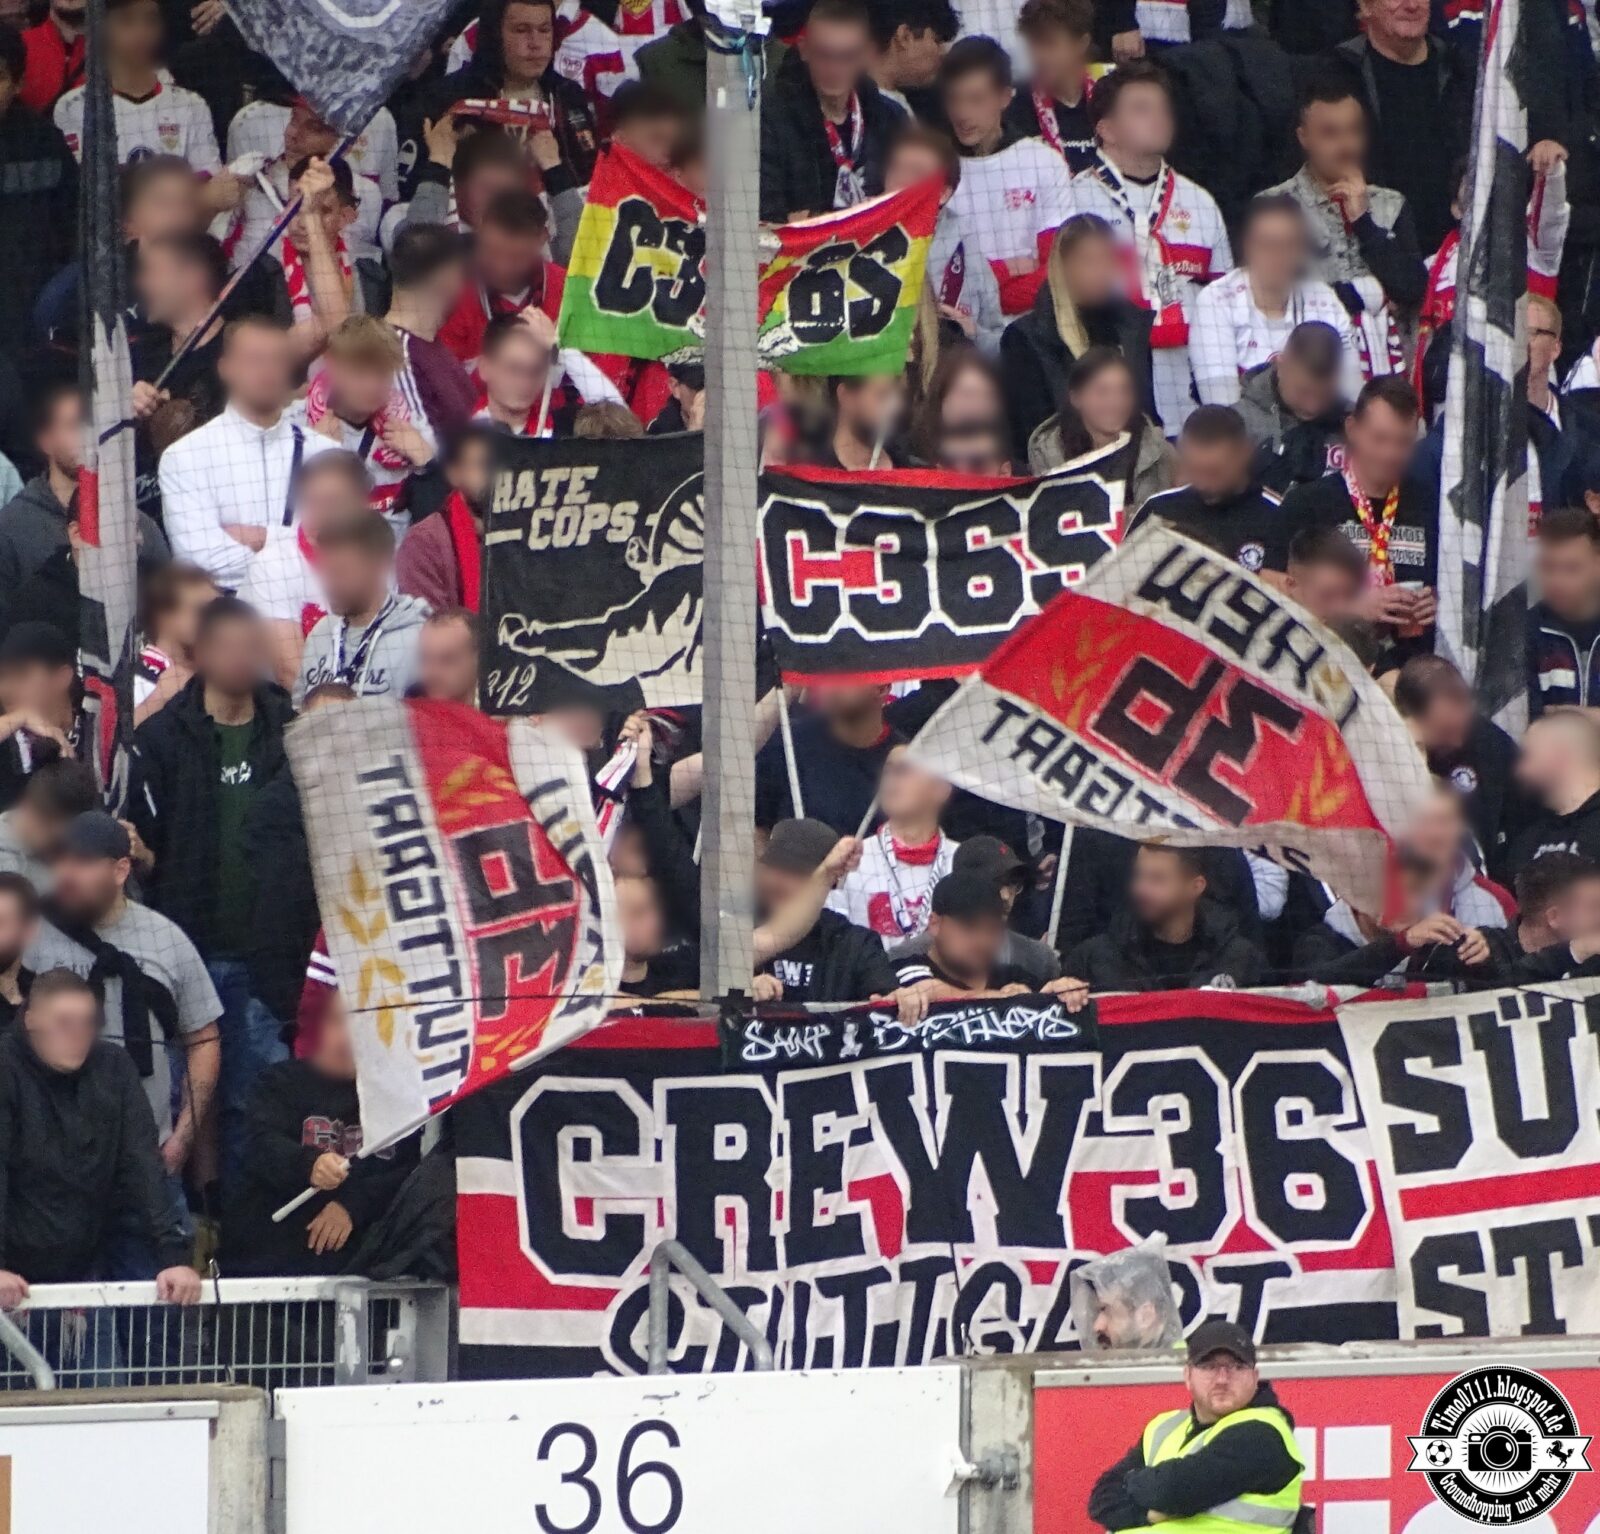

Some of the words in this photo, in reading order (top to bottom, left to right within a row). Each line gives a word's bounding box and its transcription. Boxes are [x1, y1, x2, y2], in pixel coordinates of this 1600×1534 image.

[492, 466, 599, 514] HATE
[527, 500, 639, 550] COPS
[757, 472, 1125, 642] C36S
[1373, 990, 1600, 1175] SÜ
[1411, 1215, 1600, 1340] ST
[534, 1418, 683, 1534] 36
